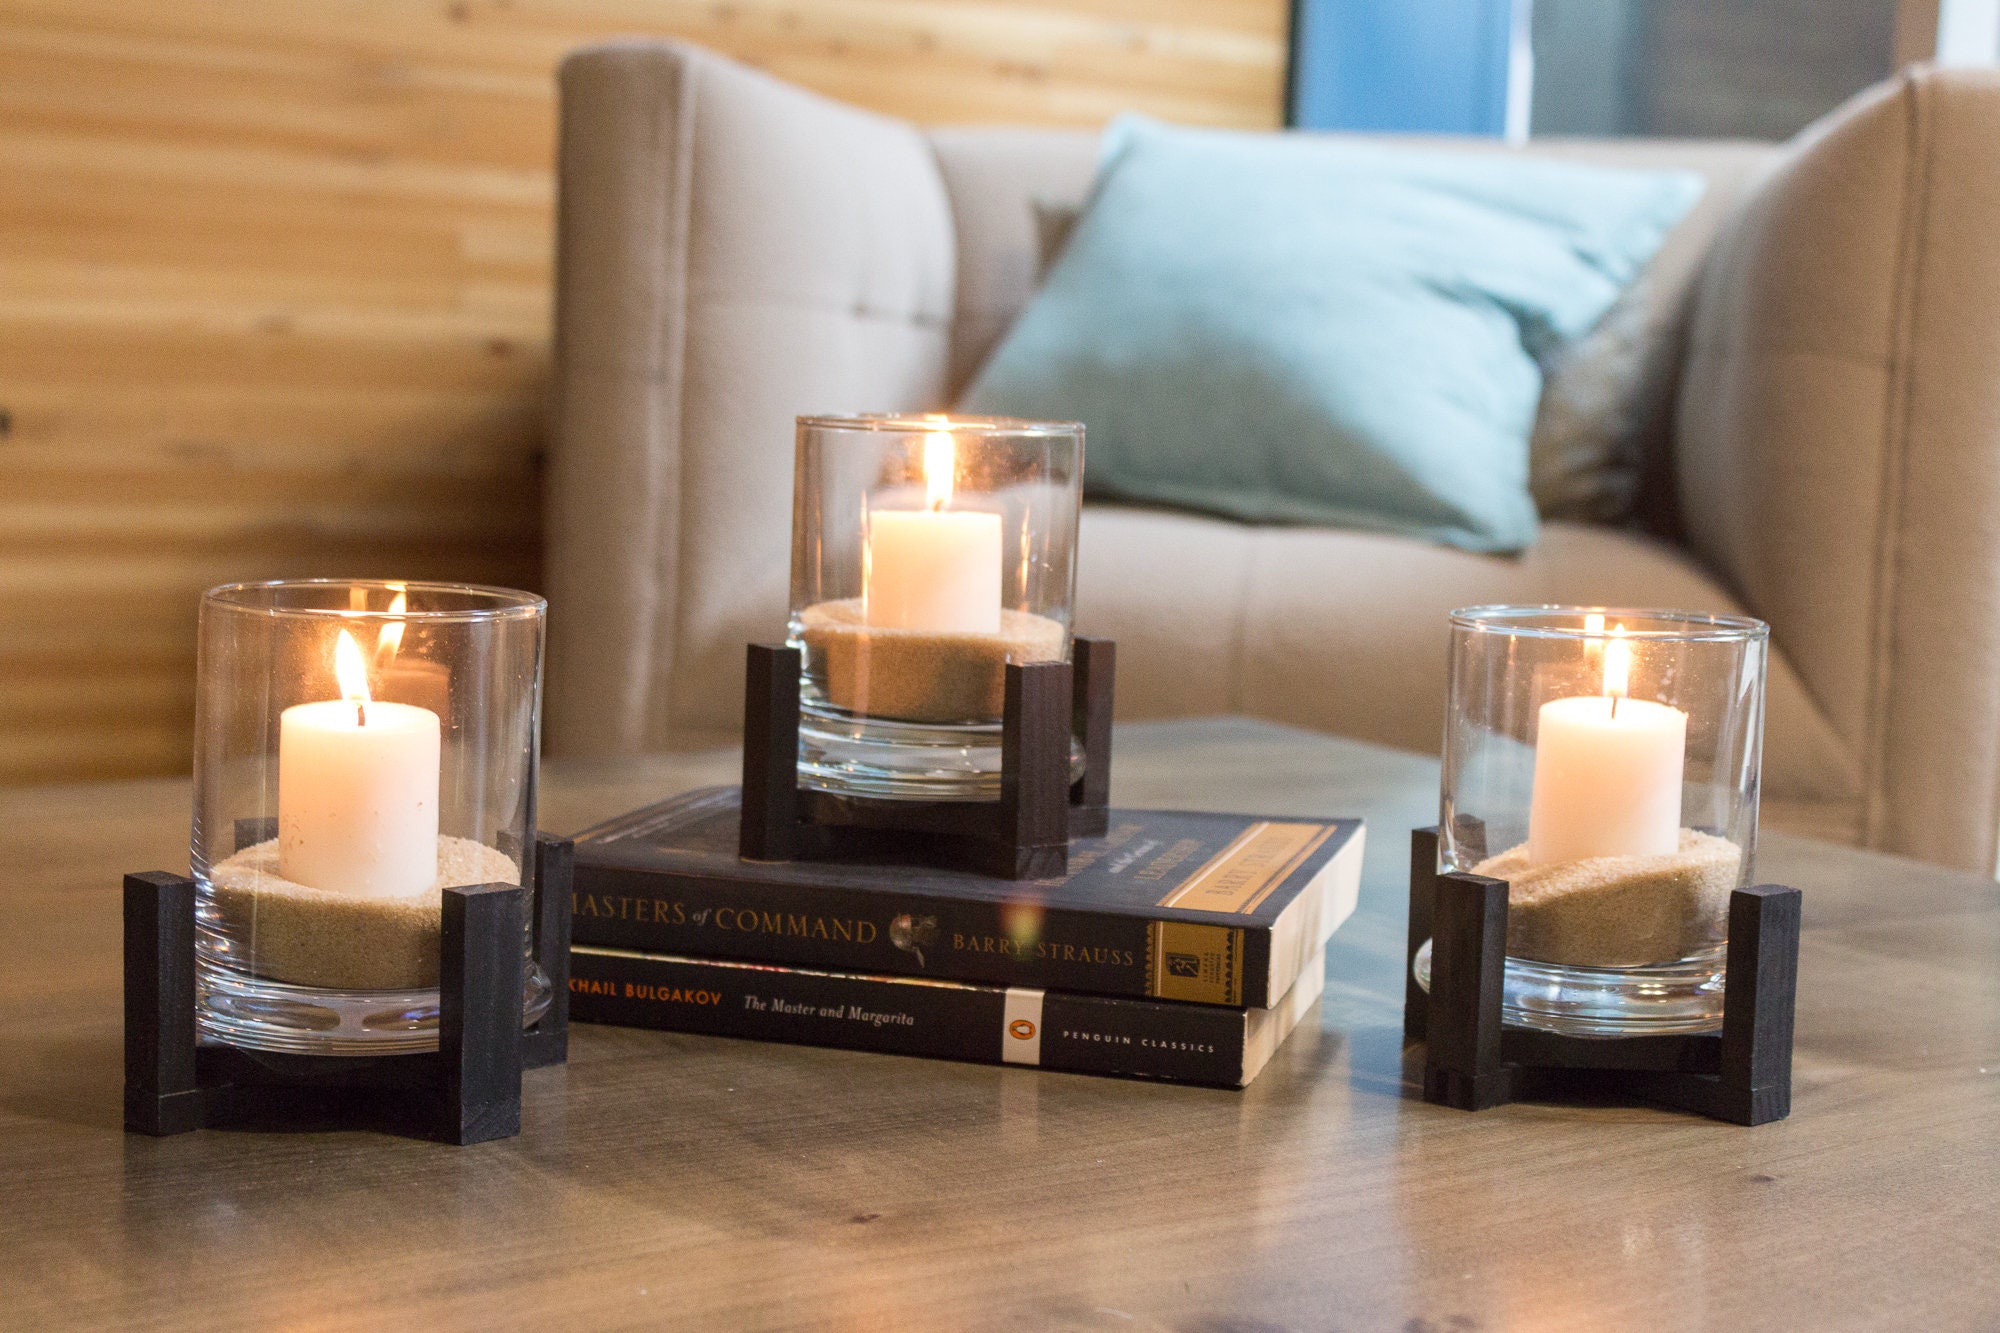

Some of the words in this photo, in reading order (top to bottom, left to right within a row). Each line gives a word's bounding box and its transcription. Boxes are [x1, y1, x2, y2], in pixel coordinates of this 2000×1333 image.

[692, 908, 712, 927] of
[715, 907, 877, 944] COMMAND
[953, 934, 1024, 956] BARRY
[1037, 942, 1135, 967] STRAUSS
[569, 977, 617, 996] KHAIL
[625, 982, 722, 1006] BULGAKOV
[744, 995, 767, 1012] The
[771, 998, 816, 1016] Master
[819, 1005, 844, 1020] and
[848, 1005, 914, 1028] Margarita
[1063, 1030, 1131, 1045] PENGUIN
[1141, 1037, 1215, 1053] CLASSICS
